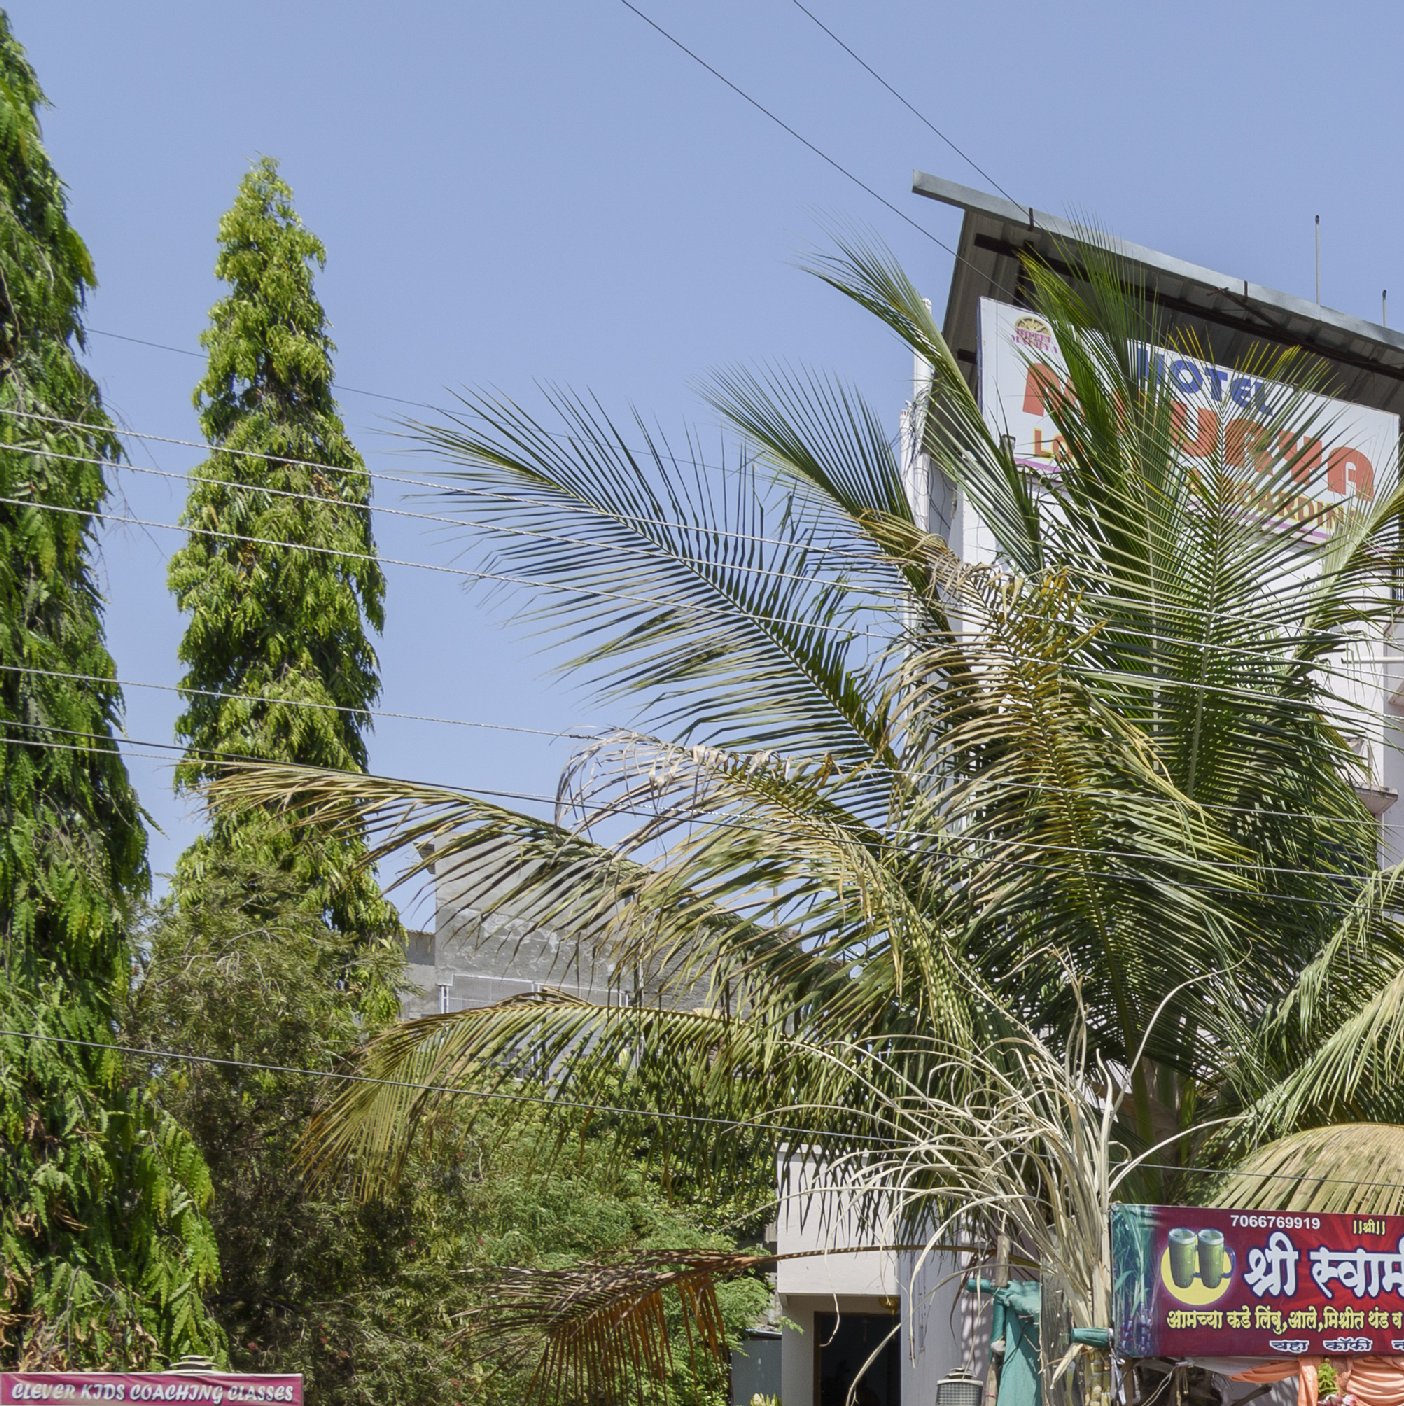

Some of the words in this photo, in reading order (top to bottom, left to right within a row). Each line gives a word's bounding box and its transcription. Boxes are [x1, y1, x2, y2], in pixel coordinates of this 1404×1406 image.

[1230, 1215, 1321, 1230] 7066769919
[1244, 1231, 1299, 1297] श्री
[1167, 1310, 1223, 1329] आमच्या
[1227, 1305, 1251, 1329] कडे
[1368, 1306, 1389, 1329] थंड
[1392, 1312, 1402, 1329] व
[1270, 1340, 1309, 1353] चहा
[12, 1383, 76, 1399] CLEVER
[81, 1384, 125, 1400] KIDS
[130, 1384, 223, 1404] COACHING
[228, 1385, 293, 1401] CLASSES
